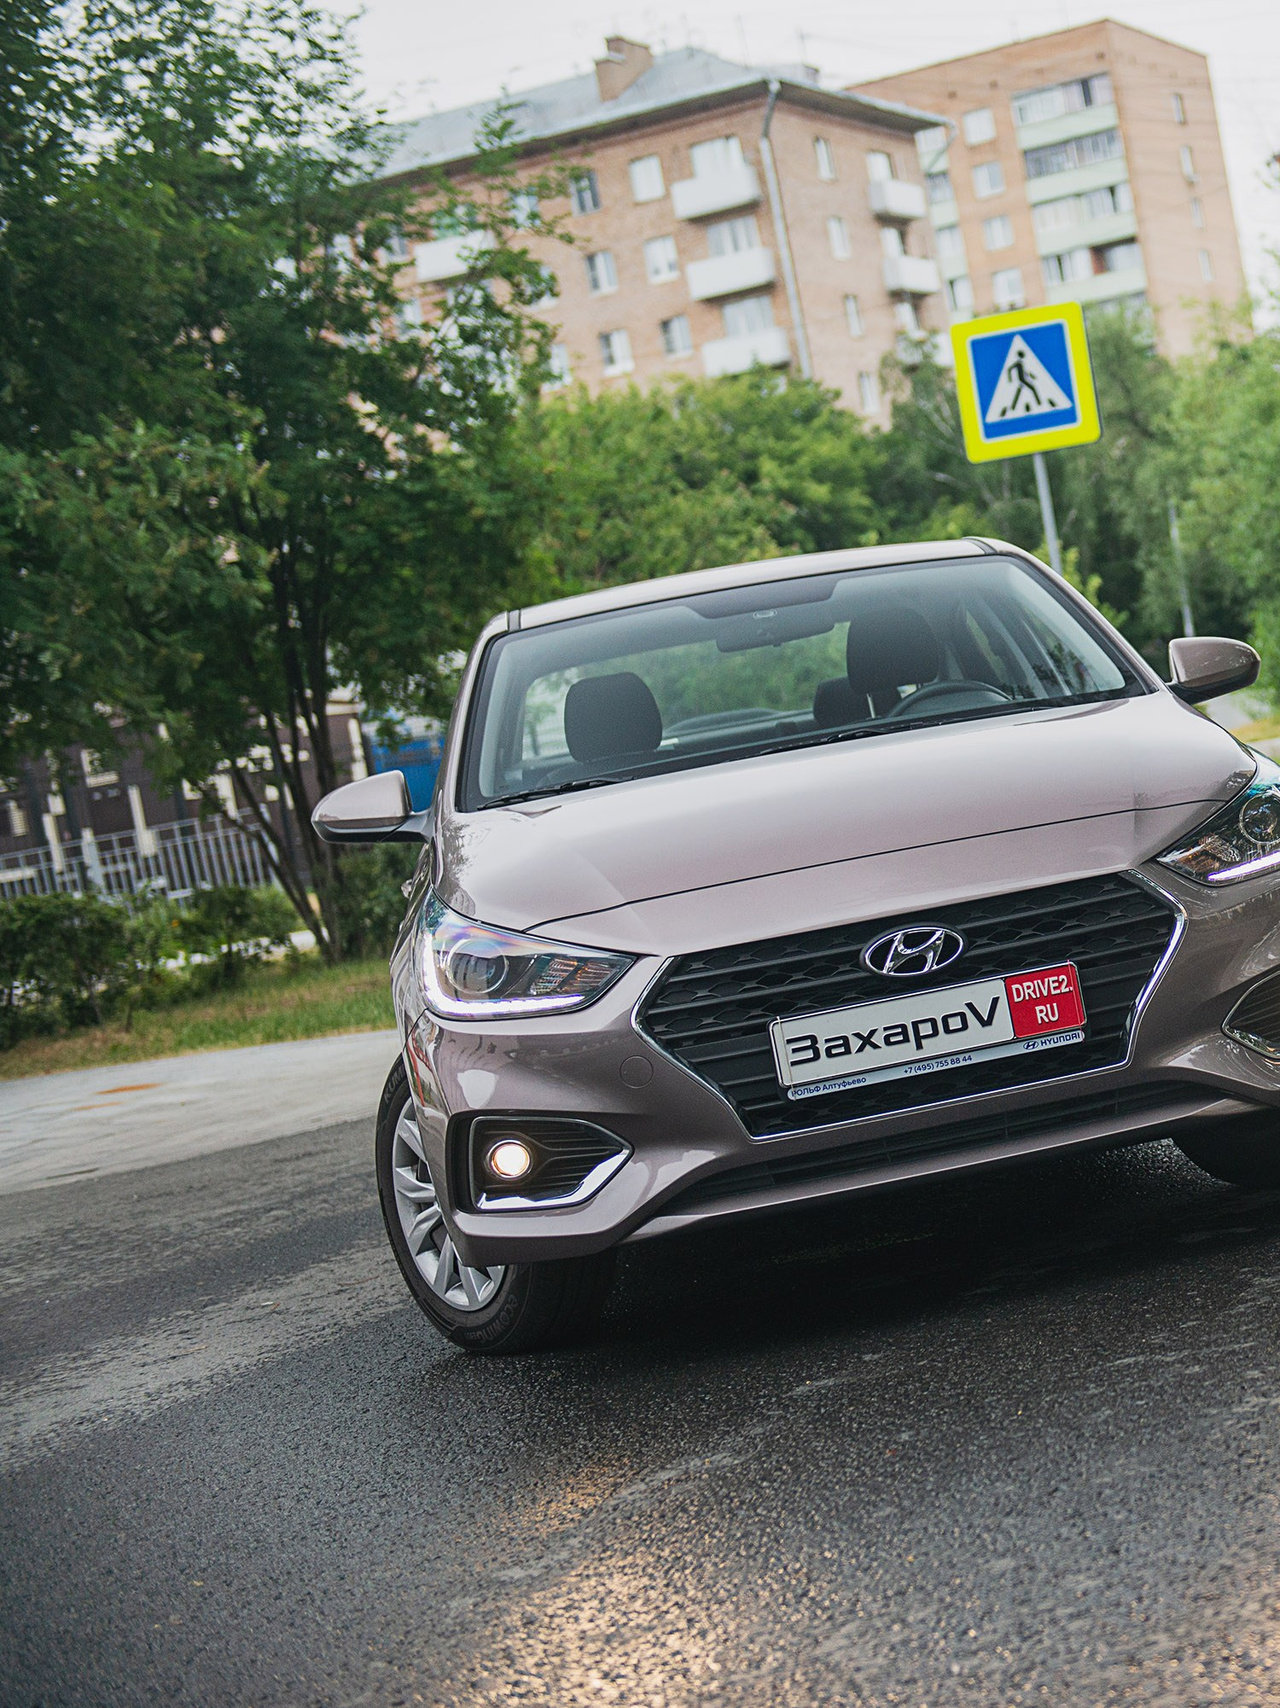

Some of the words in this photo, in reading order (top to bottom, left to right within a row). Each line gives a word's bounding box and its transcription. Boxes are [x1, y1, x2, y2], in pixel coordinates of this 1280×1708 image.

[1011, 974, 1073, 1003] DRIVE2.
[1035, 1002, 1059, 1024] RU
[1040, 1032, 1080, 1047] HYUNDAI
[904, 1066, 913, 1074] +7
[914, 1062, 934, 1073] (495)
[935, 1059, 949, 1069] 755
[950, 1056, 961, 1065] 88
[962, 1054, 973, 1063] 44
[791, 1085, 821, 1097] РОЛЬФ
[822, 1077, 867, 1092] Алтуфьево
